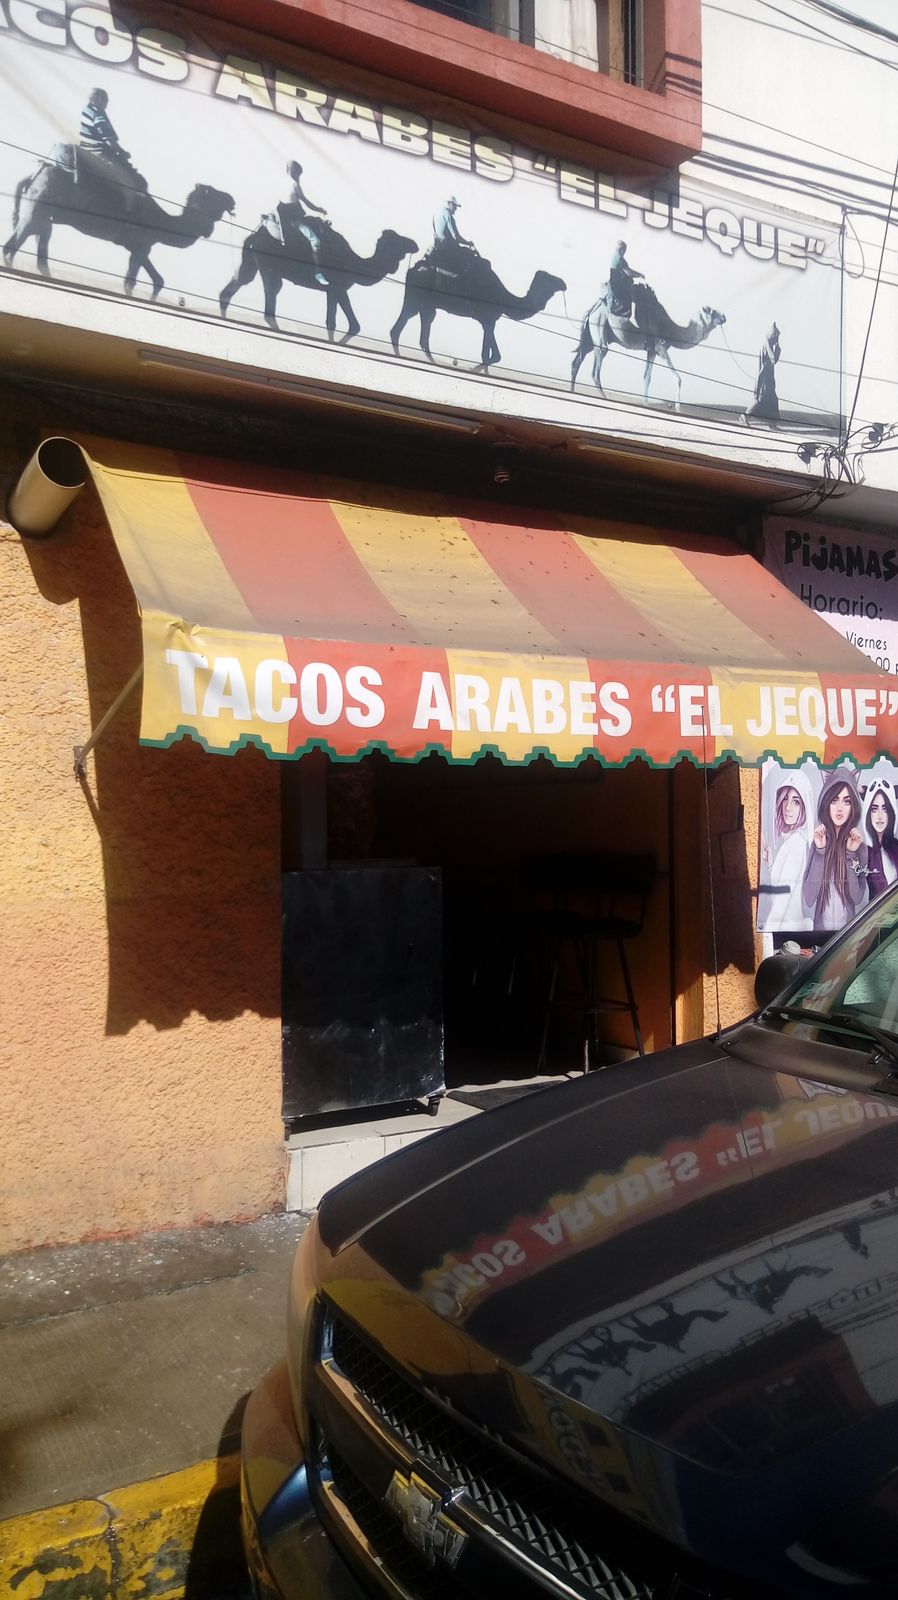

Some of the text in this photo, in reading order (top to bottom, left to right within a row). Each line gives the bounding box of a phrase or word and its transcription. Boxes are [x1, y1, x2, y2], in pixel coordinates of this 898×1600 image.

[0, 0, 190, 82] COS
[215, 54, 515, 182] ARABES
[801, 583, 883, 621] Horario:
[845, 631, 888, 651] Viernes
[165, 649, 386, 728] TACOS
[412, 671, 632, 737] ARABES
